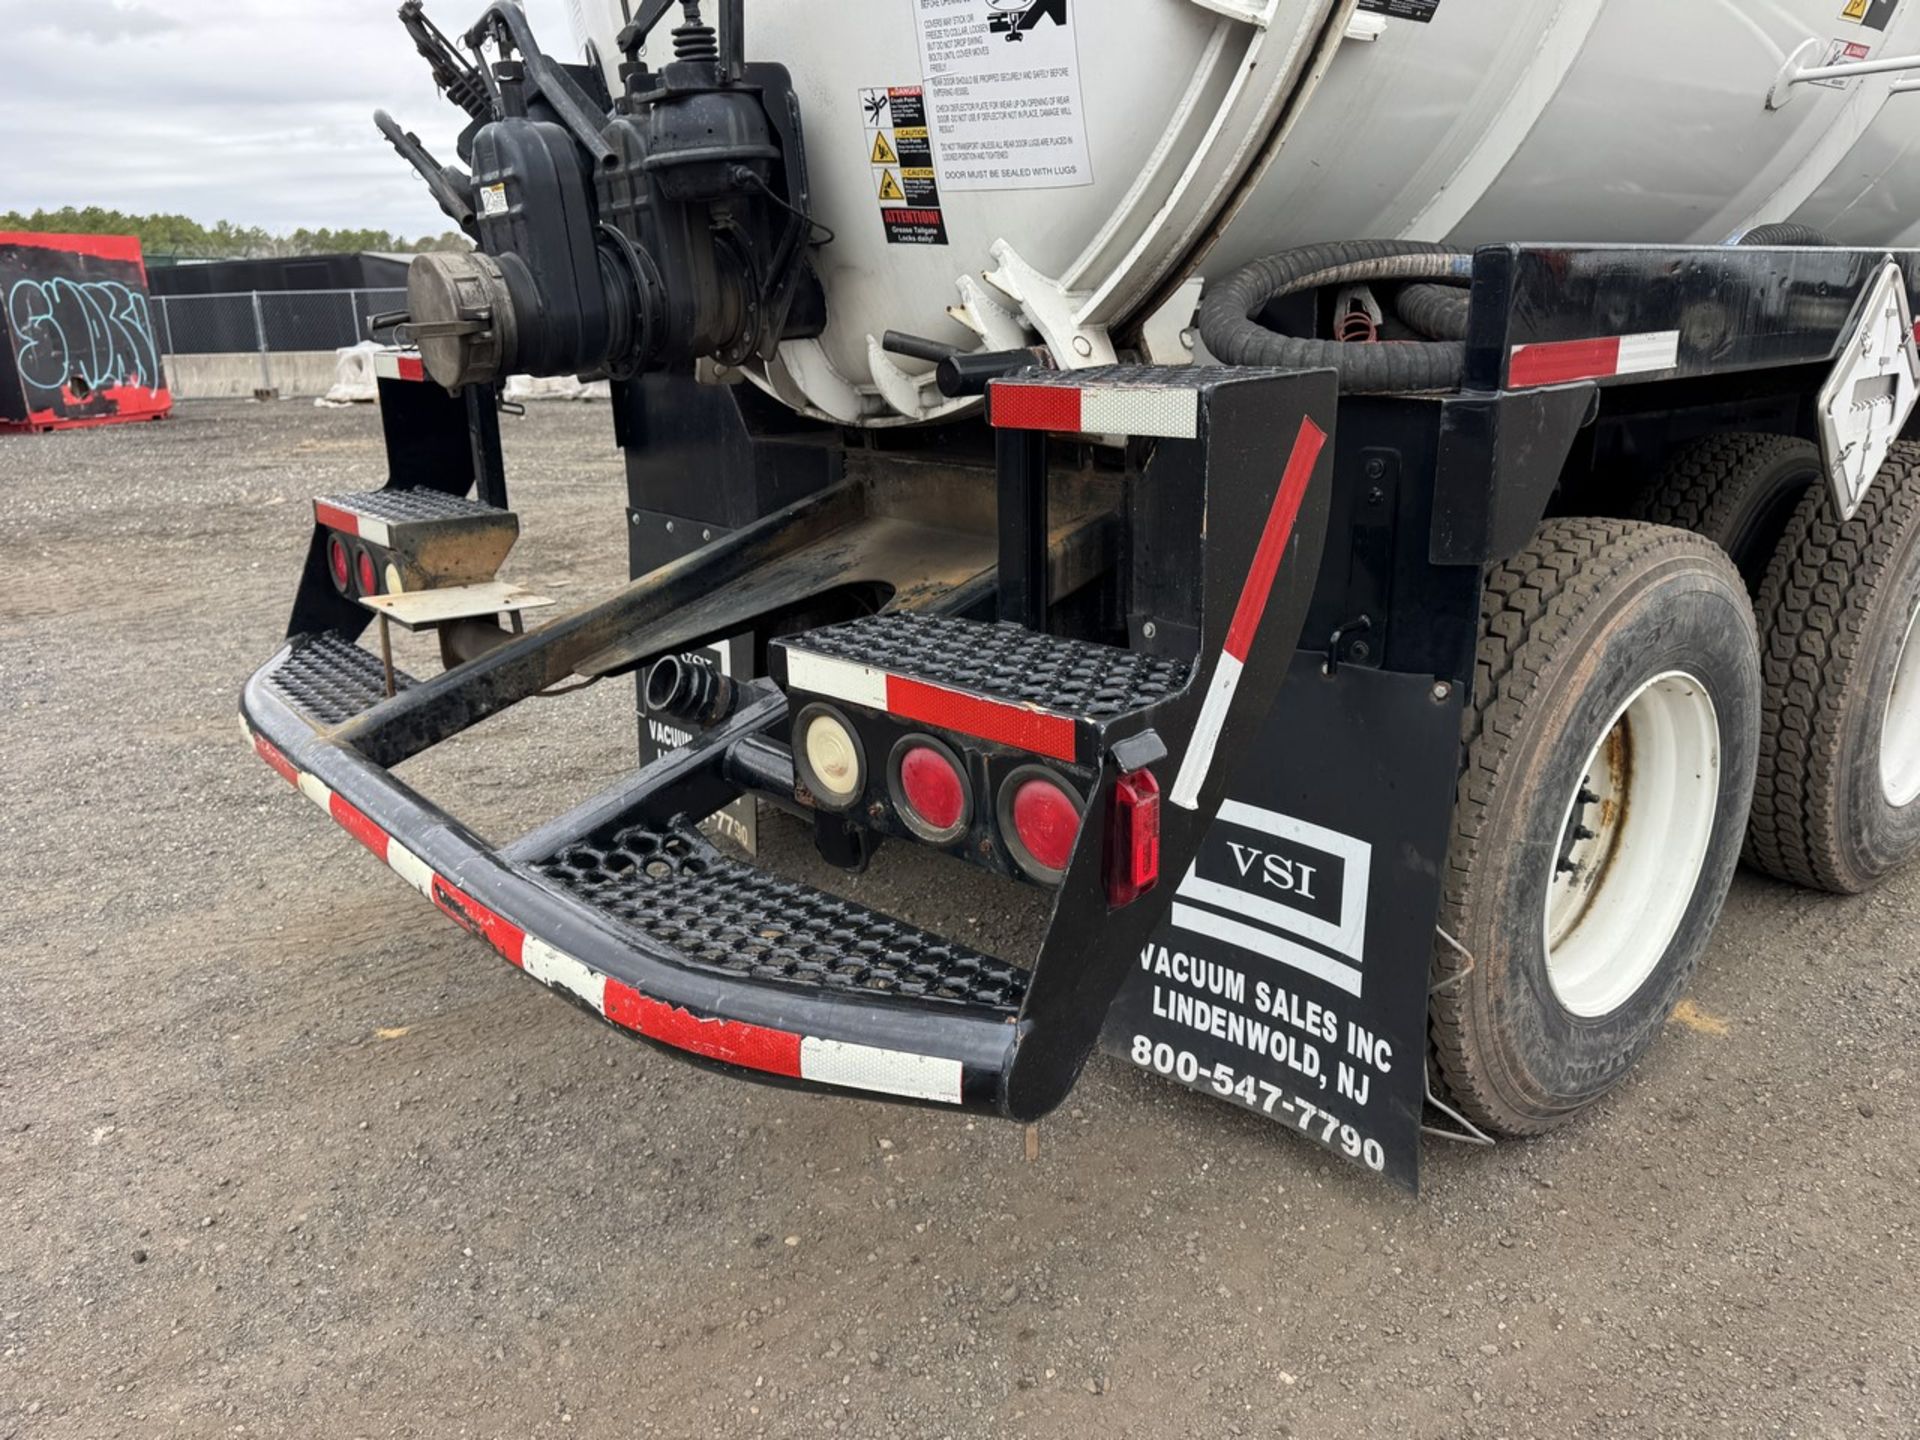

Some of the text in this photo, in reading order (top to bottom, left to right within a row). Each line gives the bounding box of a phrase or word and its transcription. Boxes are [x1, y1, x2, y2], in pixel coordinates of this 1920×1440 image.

[907, 168, 934, 176] CAUTION
[945, 165, 1077, 180] DOOR MUST BE SEALED WITH LUGS
[884, 209, 940, 224] ATTENTION!
[914, 226, 937, 235] Tailgate
[898, 234, 934, 243] Locks daily!
[1226, 841, 1317, 900] VSI
[1140, 943, 1393, 1073] VACUUM SALES INC
[1153, 986, 1370, 1106] LINDENWOLD, NJ
[1130, 1034, 1386, 1173] 800-547-7790
